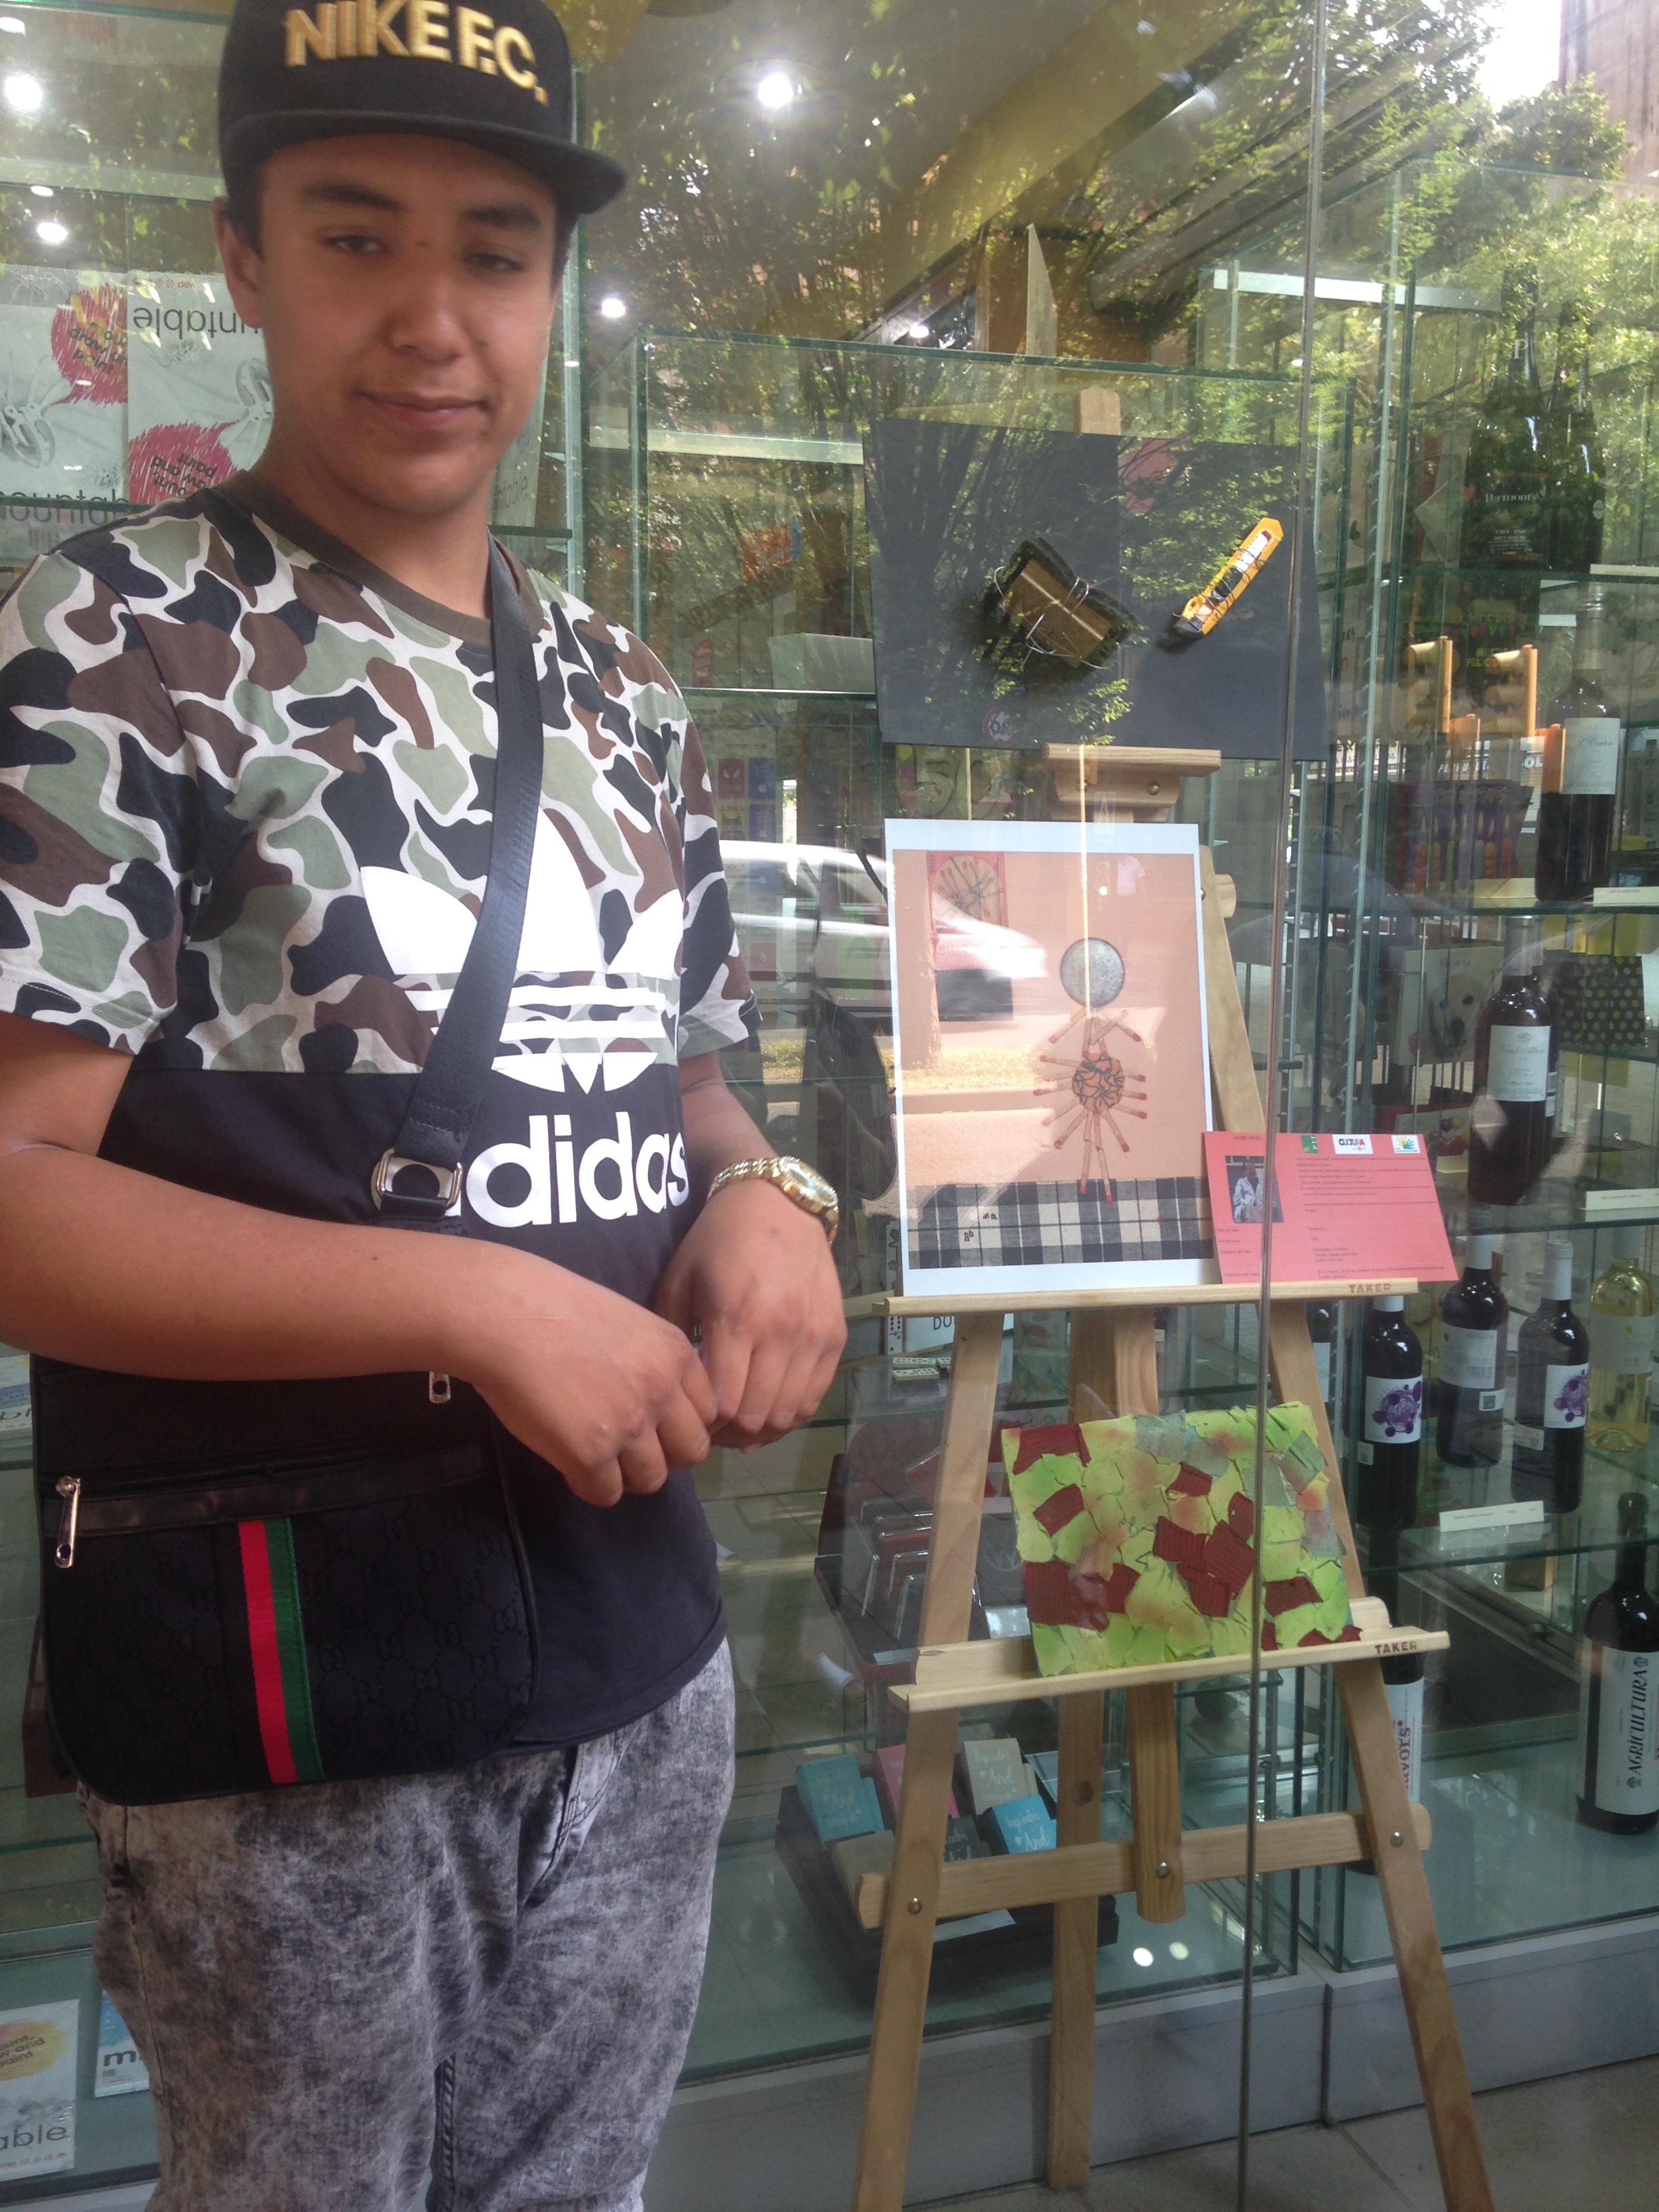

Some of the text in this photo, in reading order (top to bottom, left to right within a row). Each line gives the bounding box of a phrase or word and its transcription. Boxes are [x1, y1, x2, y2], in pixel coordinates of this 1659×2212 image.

[285, 0, 453, 67] NIKE
[150, 456, 180, 477] and
[1338, 1138, 1366, 1146] CULTURA
[443, 1111, 690, 1228] didas
[1374, 1641, 1418, 1655] TAKER
[987, 1765, 1015, 1788] And
[1025, 1825, 1050, 1852] And
